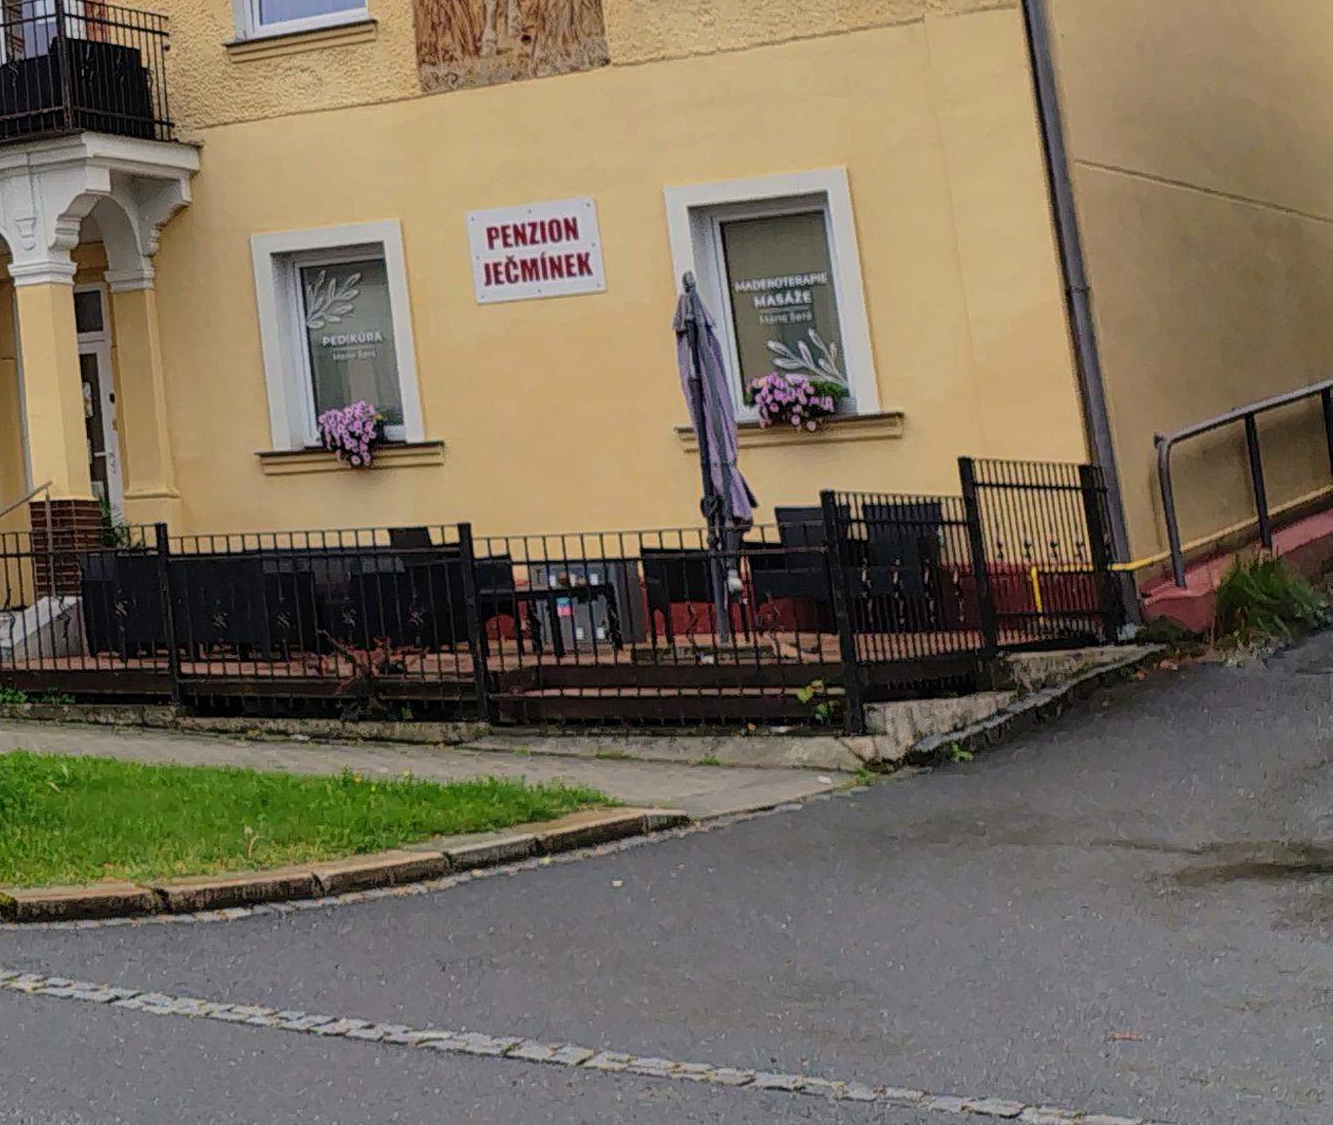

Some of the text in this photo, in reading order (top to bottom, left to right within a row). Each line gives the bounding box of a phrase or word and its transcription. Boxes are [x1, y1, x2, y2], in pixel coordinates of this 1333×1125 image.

[486, 216, 580, 250] PENZION
[484, 252, 593, 287] JEČMÍNEK
[734, 271, 828, 293] MADEROTERAPIE
